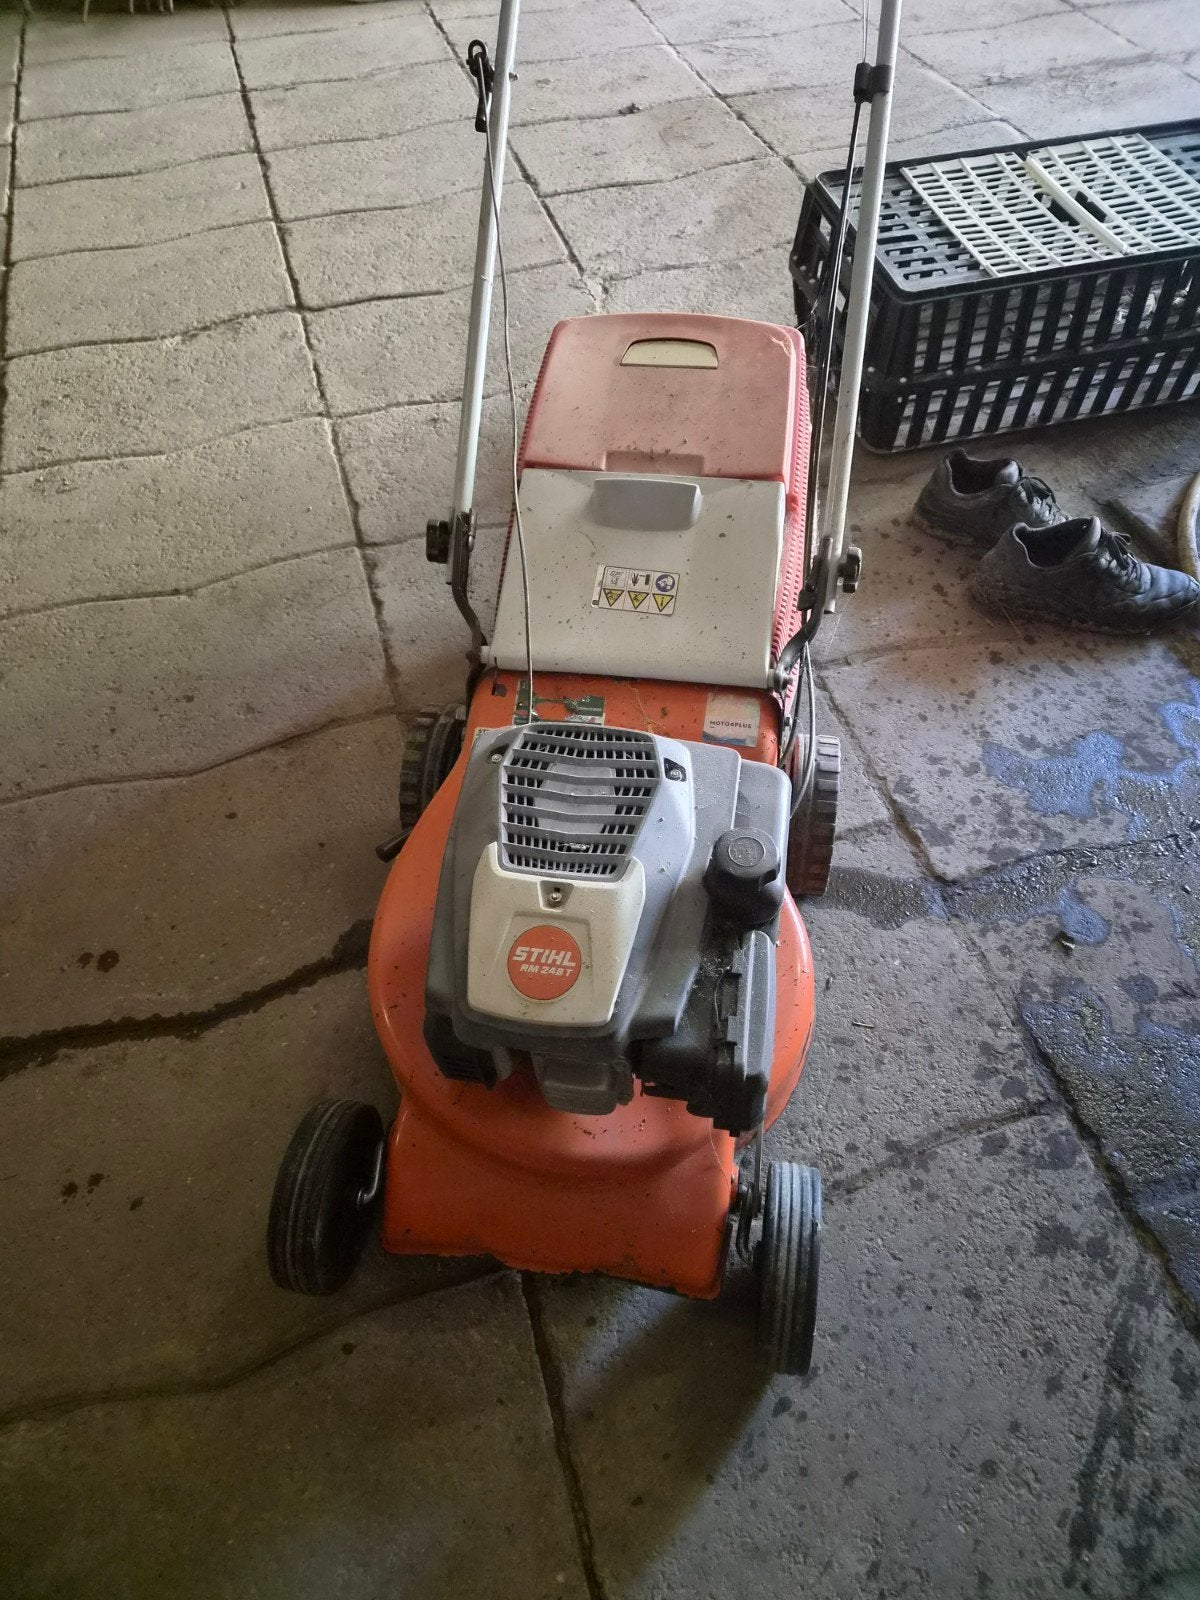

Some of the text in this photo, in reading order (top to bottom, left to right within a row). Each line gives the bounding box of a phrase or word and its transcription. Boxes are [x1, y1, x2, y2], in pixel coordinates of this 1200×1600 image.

[710, 720, 751, 728] MOTO4PLUS
[512, 946, 576, 966] STIHL
[520, 964, 573, 977] RM 248 T
